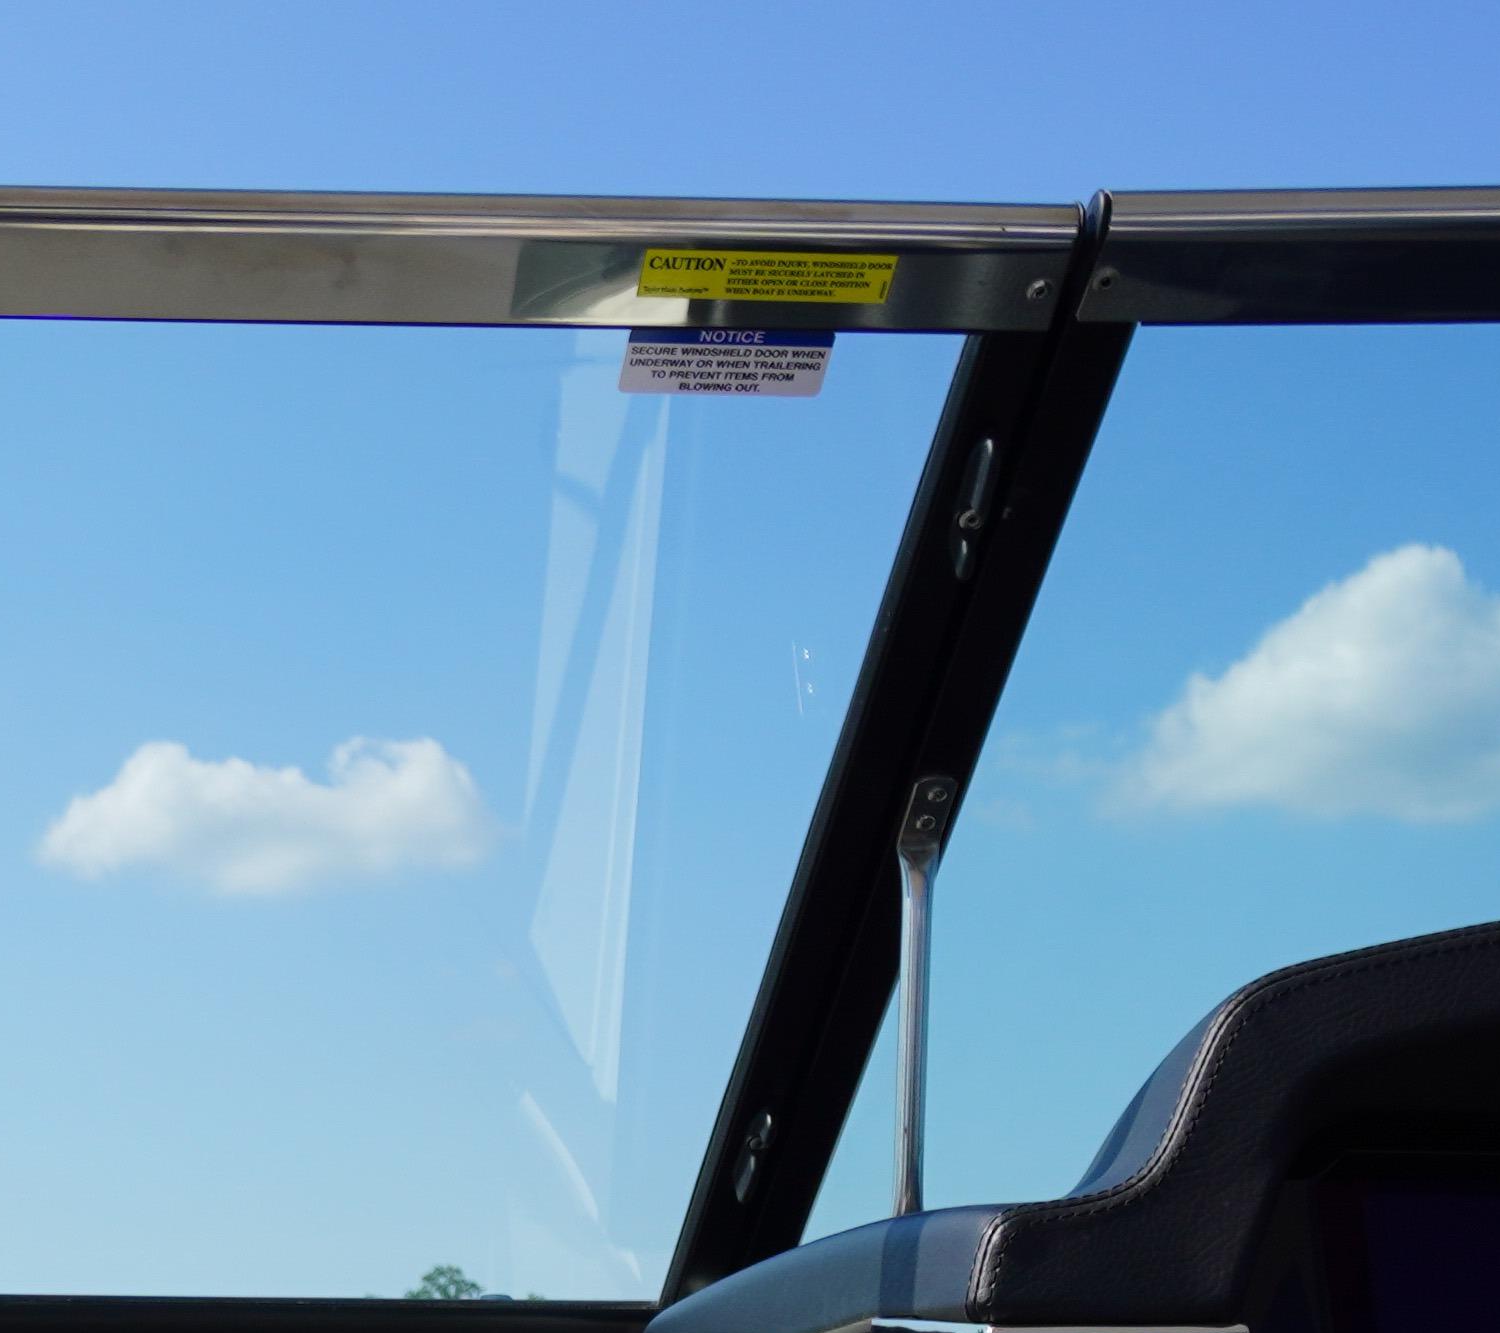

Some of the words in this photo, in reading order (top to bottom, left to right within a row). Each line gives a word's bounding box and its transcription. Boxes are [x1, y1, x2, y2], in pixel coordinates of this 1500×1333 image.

[649, 256, 727, 271] CAUTION
[700, 331, 766, 344] NOTICE
[631, 347, 677, 356] SECURE
[681, 348, 750, 358] WINDSHIELD
[754, 350, 788, 358] DOOR
[792, 350, 826, 359] WHEN
[629, 358, 693, 368] UNDERWAY
[696, 360, 713, 368] OR
[717, 360, 749, 369] WHEN
[754, 361, 821, 371] TRAILERING
[651, 370, 666, 378] TO
[669, 371, 722, 380] PREVENT
[725, 372, 758, 381] ITEMS
[761, 373, 794, 382] FROM
[679, 382, 732, 392] BLOWING
[735, 384, 760, 393] OUT.
